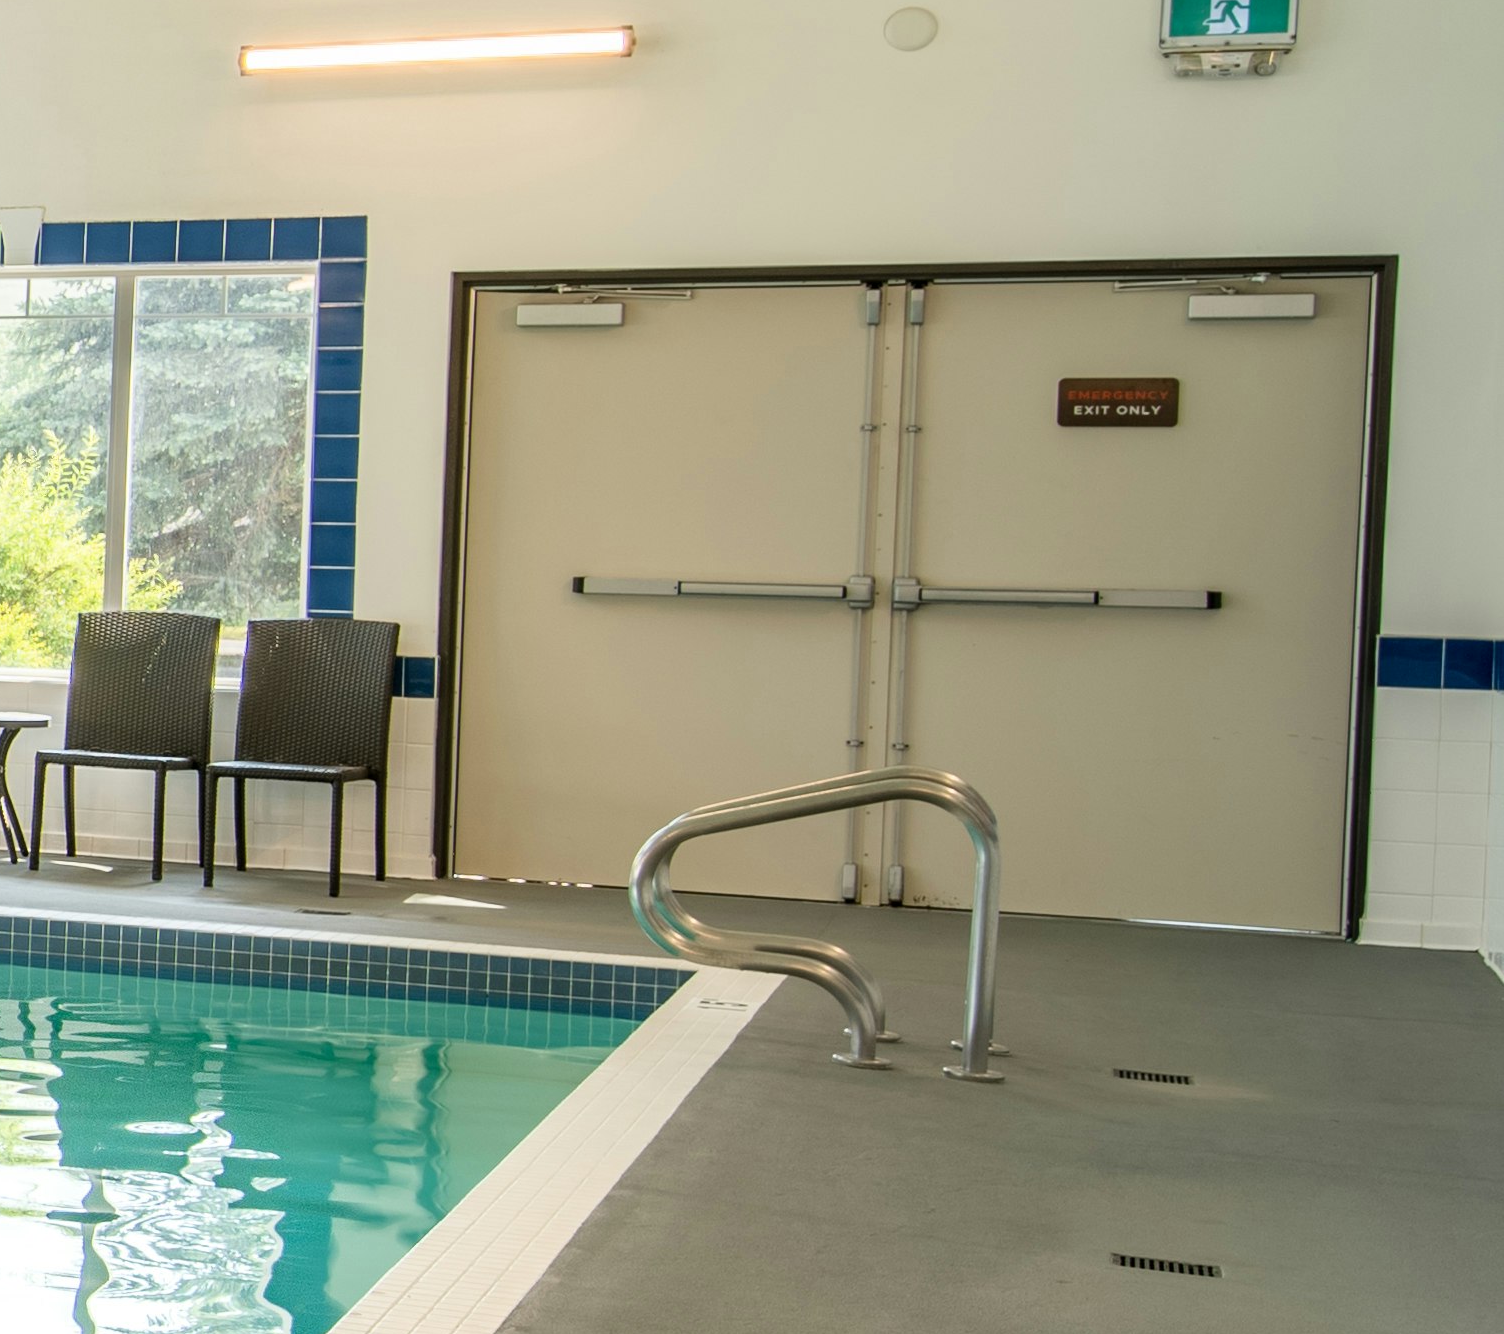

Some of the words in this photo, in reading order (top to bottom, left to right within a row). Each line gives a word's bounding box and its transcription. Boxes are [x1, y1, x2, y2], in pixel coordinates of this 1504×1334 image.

[1068, 390, 1168, 400] EMERGENCY
[1074, 405, 1110, 415] EXIT
[1116, 405, 1161, 415] ONLY
